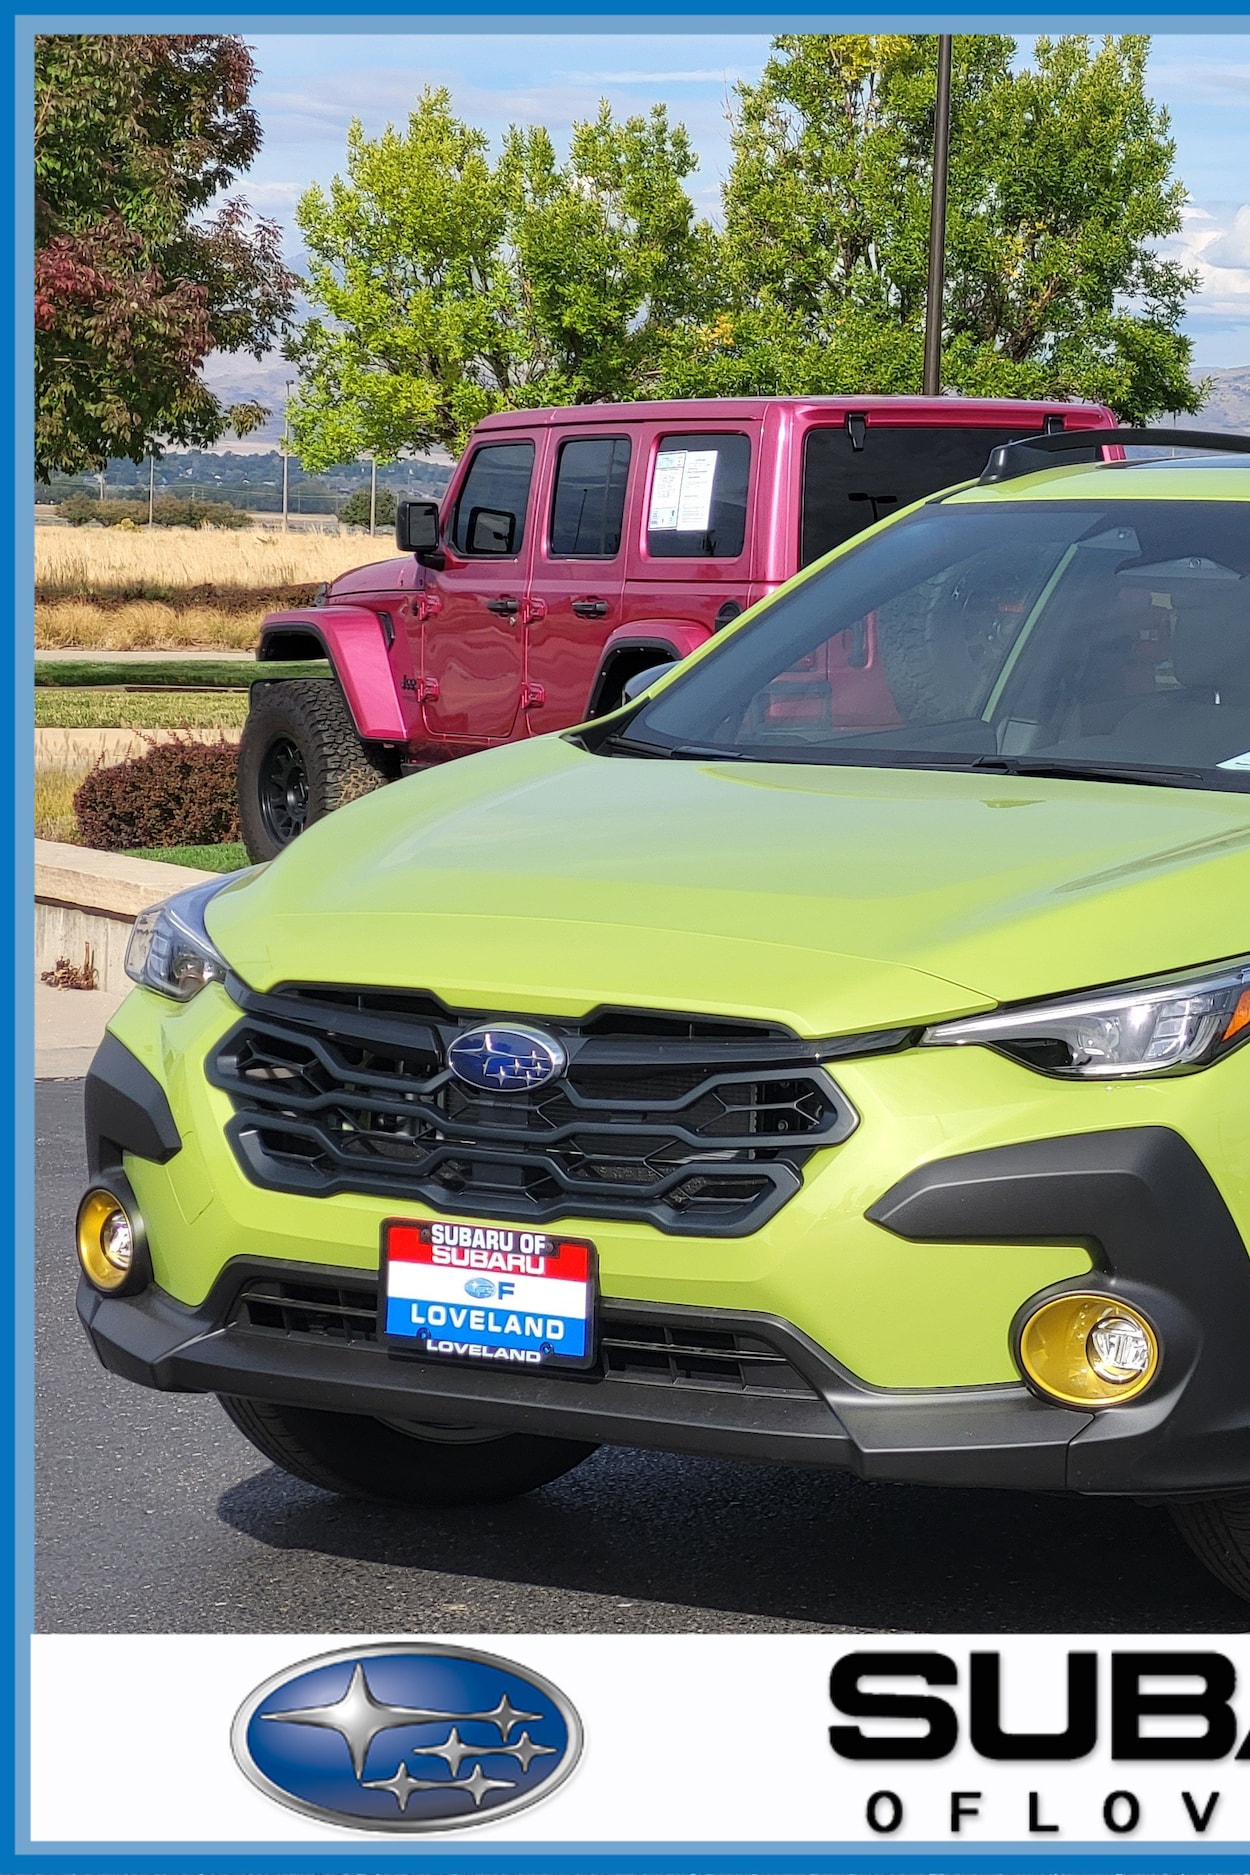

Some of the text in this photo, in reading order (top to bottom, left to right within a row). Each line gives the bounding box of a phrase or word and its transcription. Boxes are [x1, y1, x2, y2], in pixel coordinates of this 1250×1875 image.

[431, 1223, 547, 1255] SUBARU OF
[432, 1245, 547, 1275] SUBARU
[410, 1302, 564, 1341] LOVELAND
[426, 1338, 542, 1364] LOVELAND
